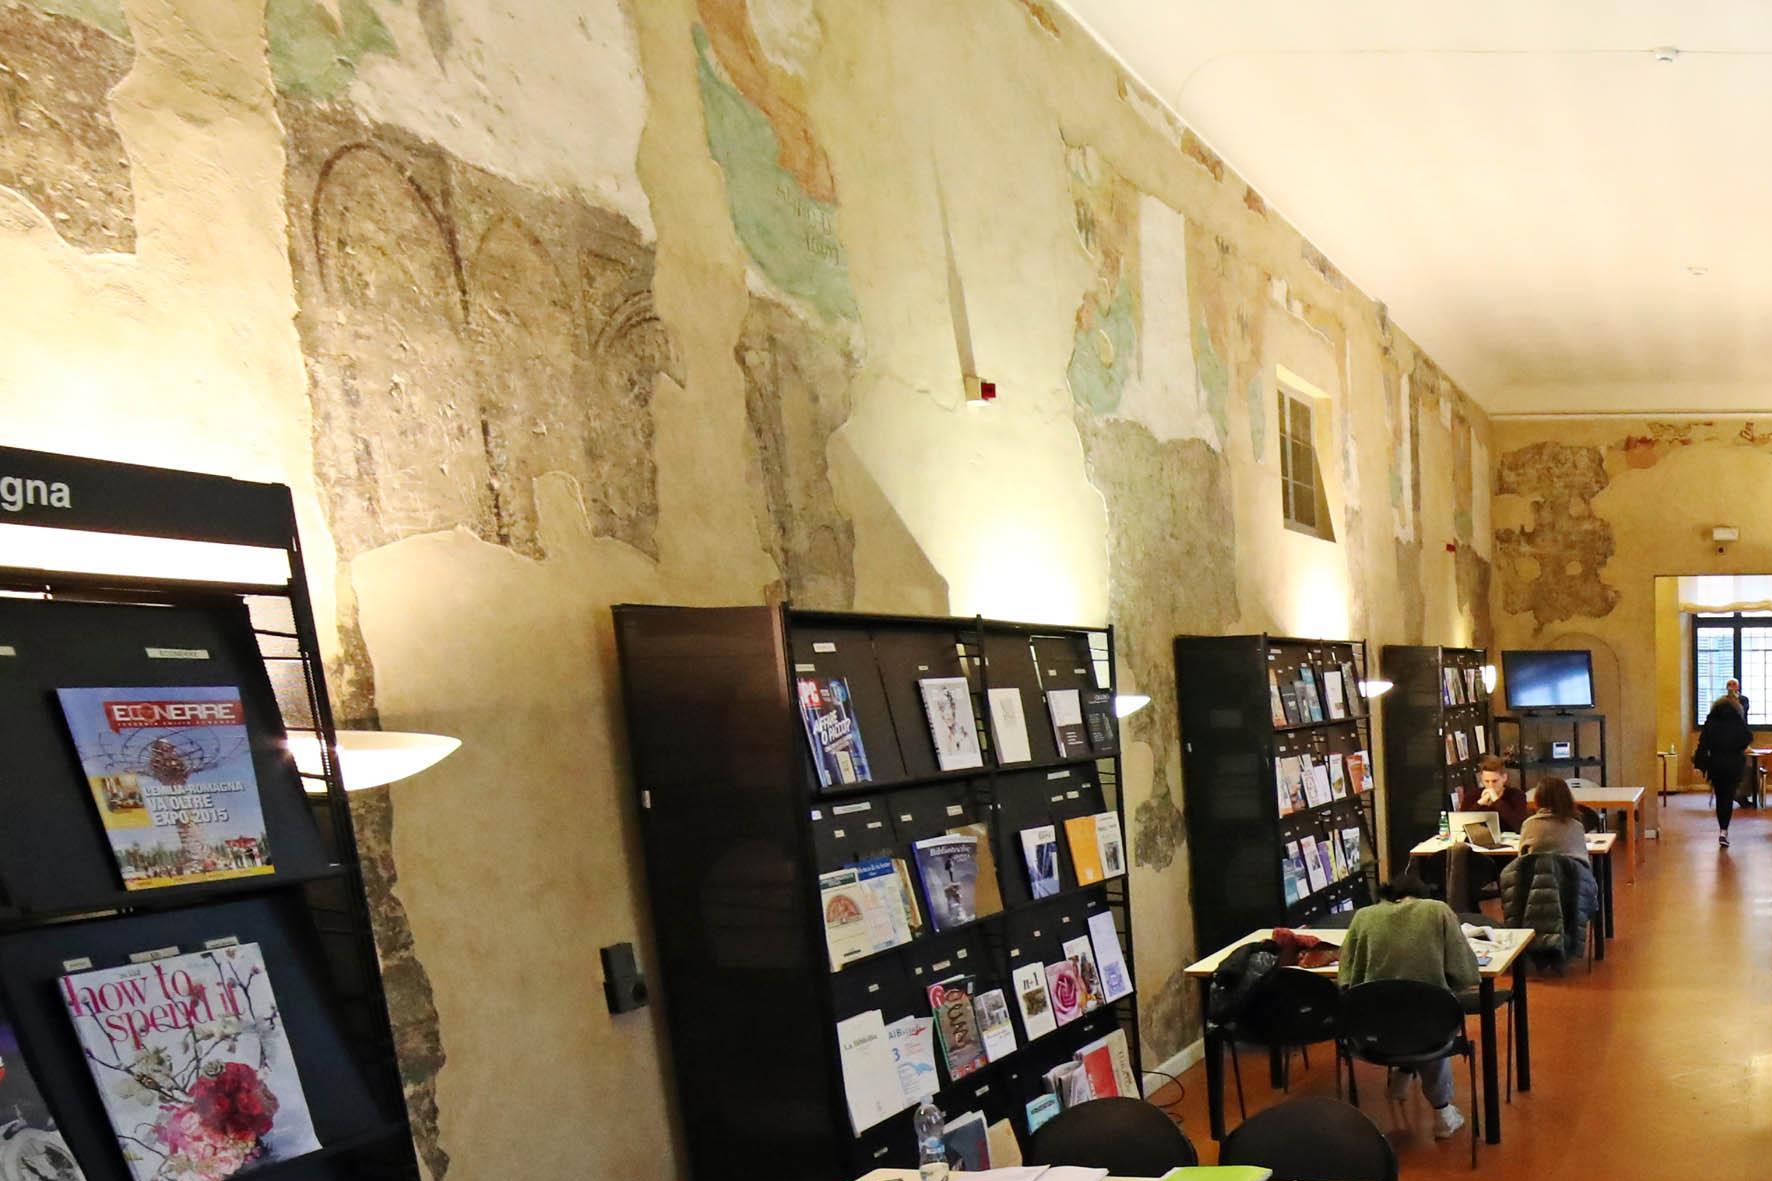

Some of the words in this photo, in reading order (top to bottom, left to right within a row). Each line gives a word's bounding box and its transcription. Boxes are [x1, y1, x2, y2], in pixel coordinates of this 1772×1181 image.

[0, 475, 72, 512] gna
[153, 812, 189, 827] EXPO
[191, 809, 230, 826] 2015
[63, 975, 148, 1017] how
[154, 962, 193, 1000] to
[105, 983, 214, 1050] spend
